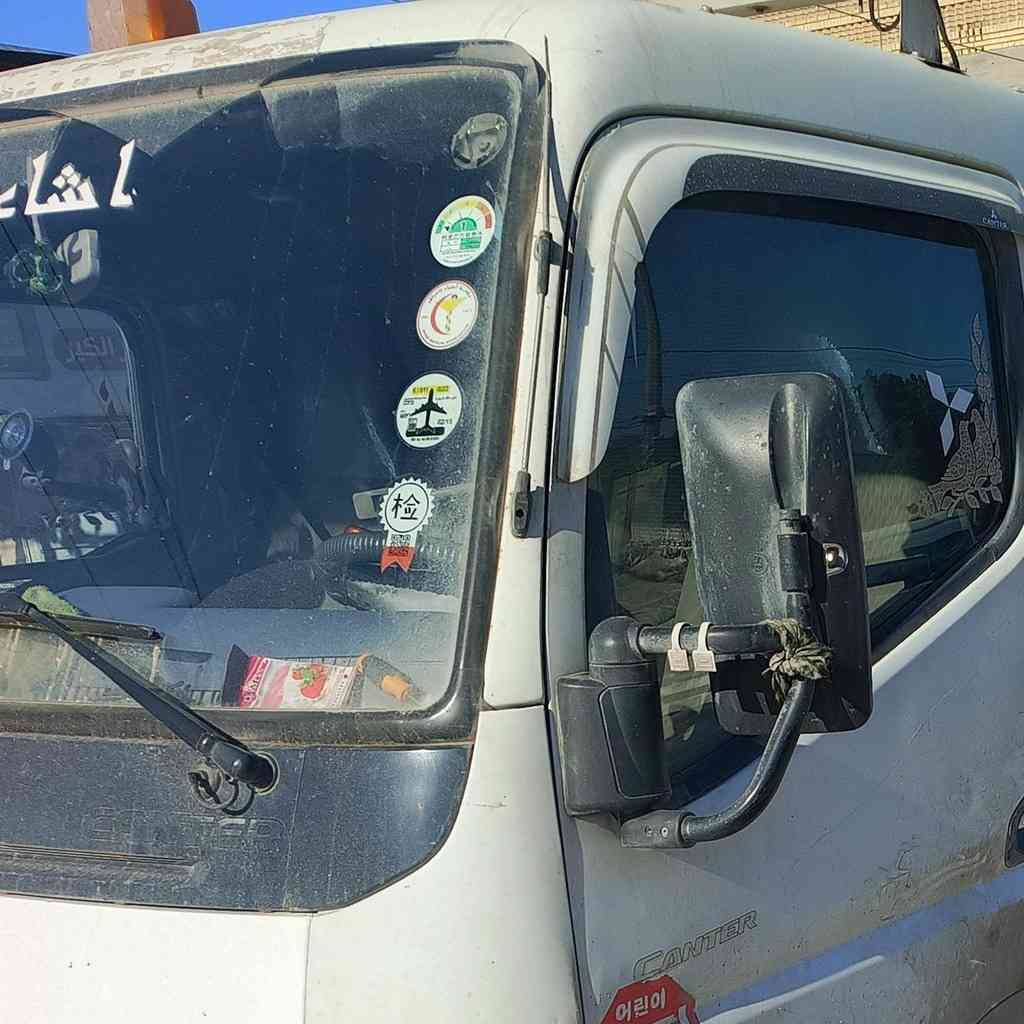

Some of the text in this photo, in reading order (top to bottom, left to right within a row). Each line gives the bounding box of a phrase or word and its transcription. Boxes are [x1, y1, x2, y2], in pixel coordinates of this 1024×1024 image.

[391, 493, 420, 520] 检
[632, 910, 758, 982] CANTER
[615, 988, 666, 1021] 어린이
